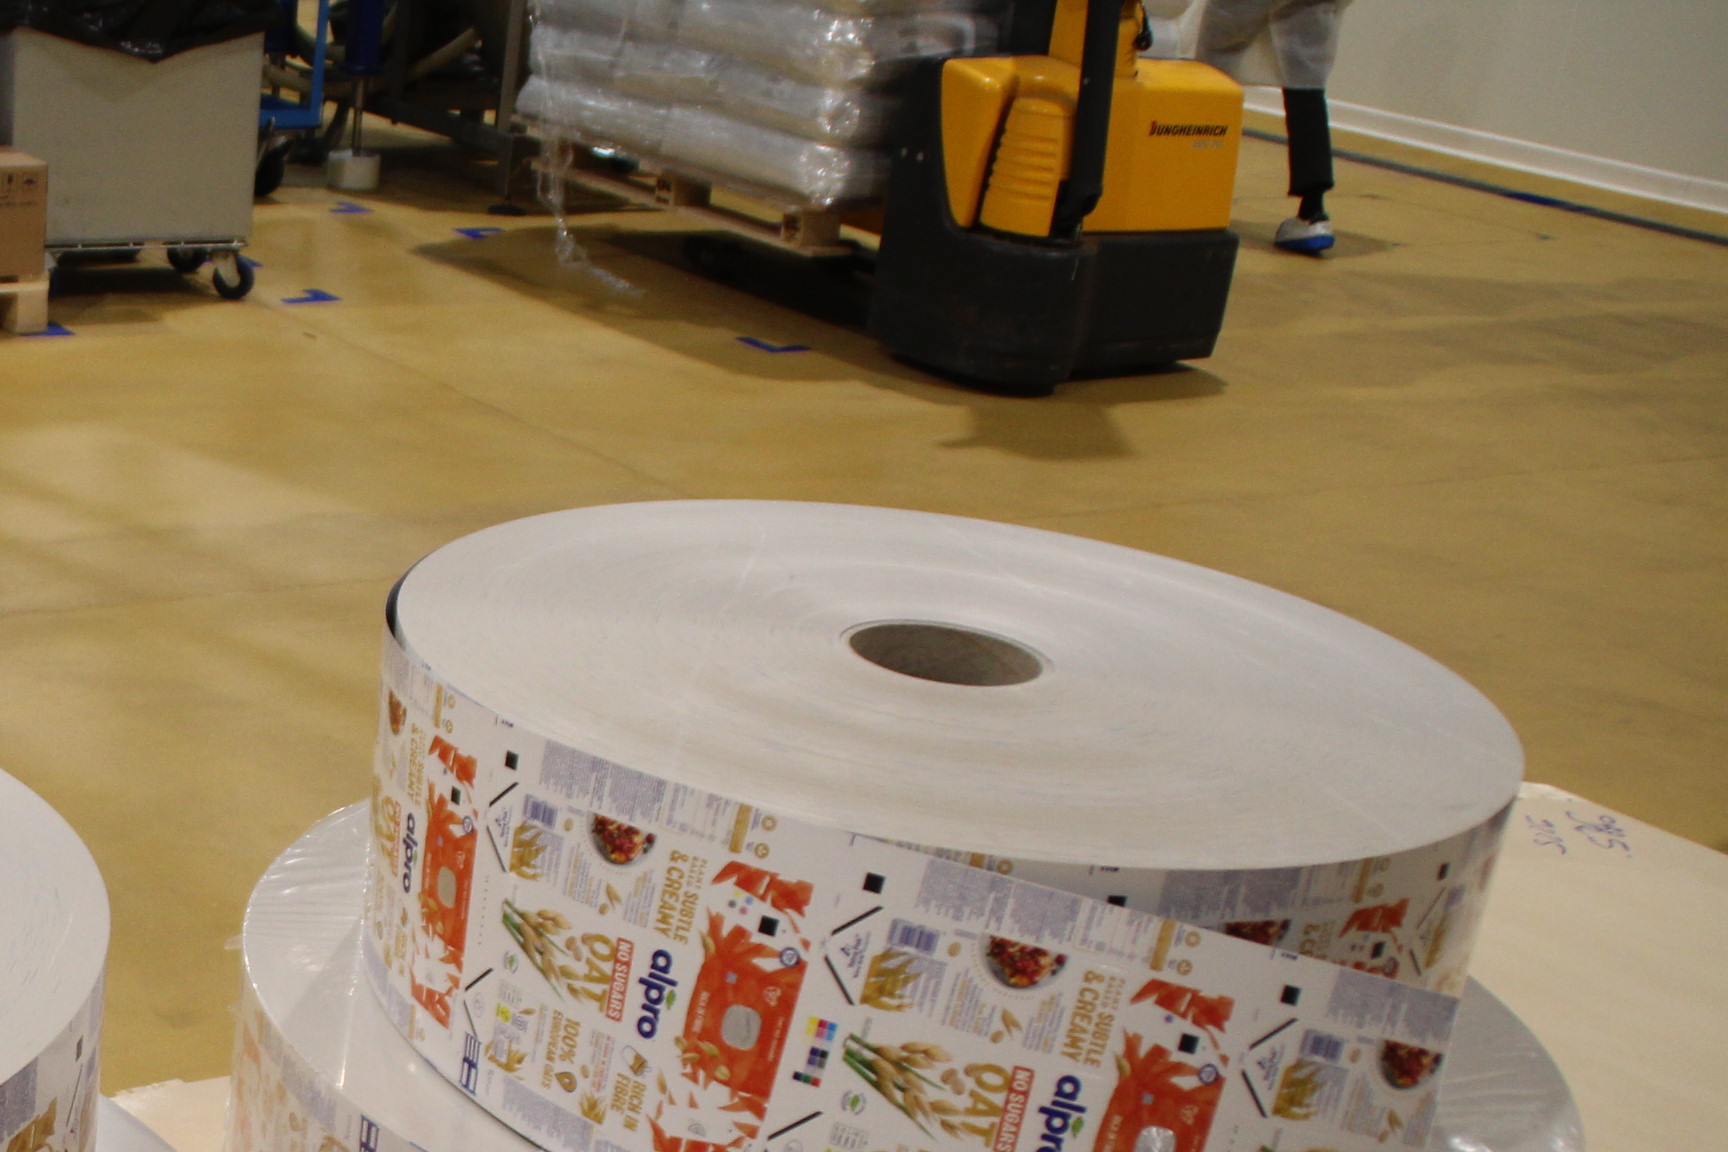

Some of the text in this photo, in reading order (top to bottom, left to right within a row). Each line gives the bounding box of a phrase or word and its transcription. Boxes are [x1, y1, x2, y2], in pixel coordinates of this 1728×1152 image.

[1149, 120, 1228, 136] JUNGHEINRICH
[403, 812, 419, 894] alpro
[654, 850, 688, 937] & CREAMY
[673, 890, 699, 944] SUBTLE
[580, 934, 617, 1013] OAT
[609, 941, 633, 1019] NO SUGARS
[636, 949, 678, 1039] alpro
[545, 1008, 564, 1063] EUROPEAN
[558, 1017, 580, 1063] 100%
[1060, 970, 1104, 1063] & CREAMY
[1083, 1012, 1114, 1068] SUBTLE
[611, 1072, 631, 1114] FIBRE
[623, 1080, 647, 1132] RICH IN
[960, 1064, 1012, 1148] OAT
[996, 1068, 1033, 1152] NO SUGARS
